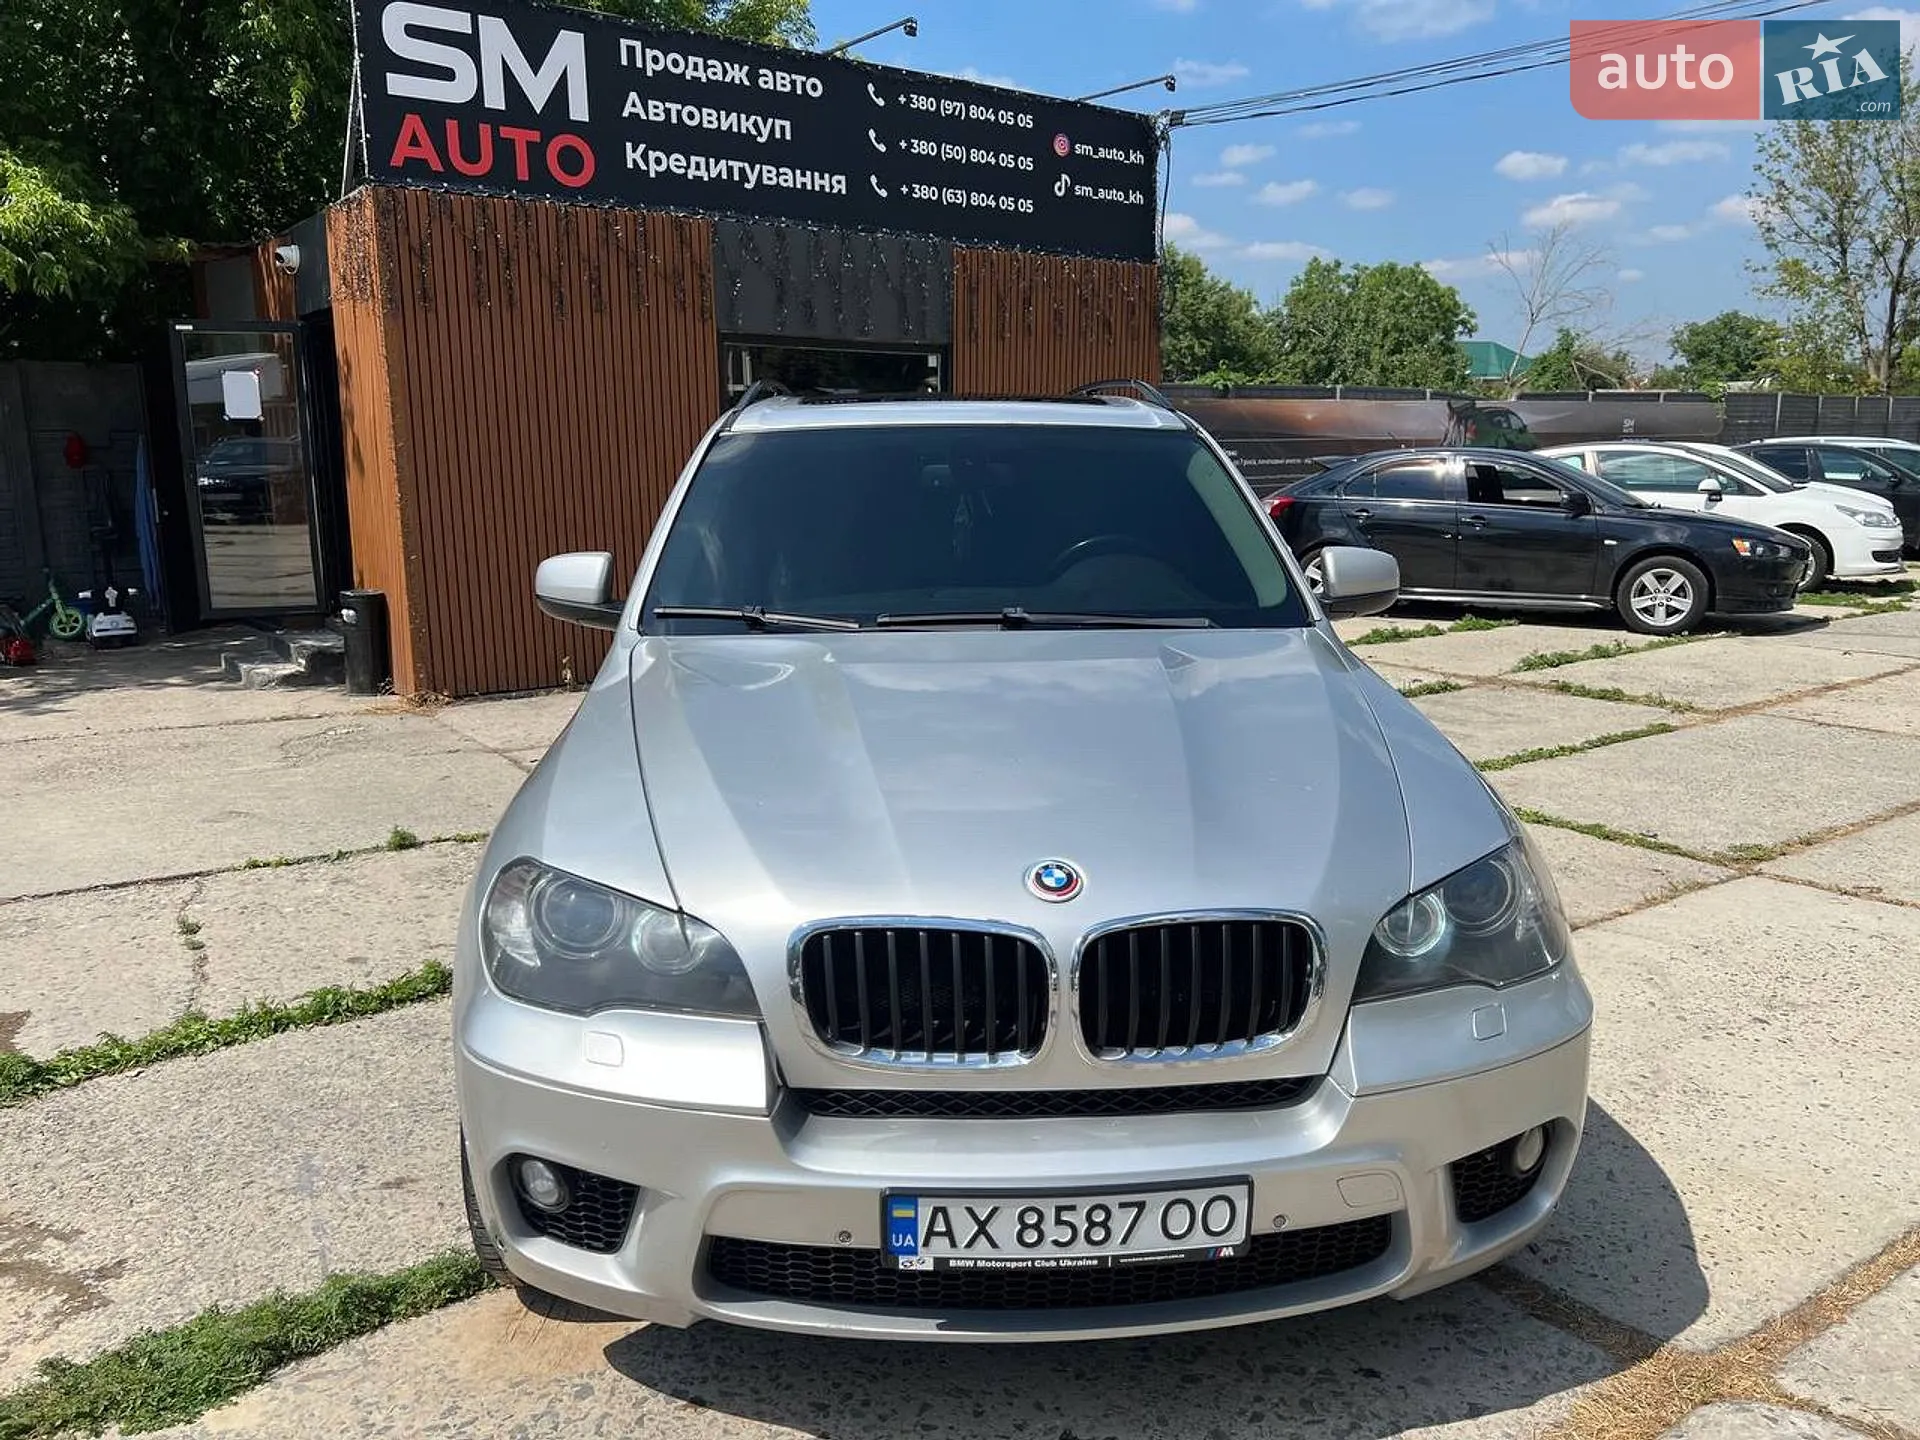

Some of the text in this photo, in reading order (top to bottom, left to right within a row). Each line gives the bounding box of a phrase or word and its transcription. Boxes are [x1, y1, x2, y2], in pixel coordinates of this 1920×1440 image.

[381, 1, 589, 122] SM
[619, 38, 824, 98] Продаж авто
[622, 91, 792, 143] Автовикуп
[898, 94, 1034, 129] + 380 (97) 804 05 05
[390, 113, 596, 188] AUTO
[899, 139, 1034, 171] + 380 (50) 804 05 05
[1074, 143, 1145, 165] sm_auto_kh
[625, 142, 848, 195] Кредитування
[900, 183, 1034, 213] + 380 (63) 804 05 05
[1074, 184, 1144, 205] sm_auto_kh
[892, 1232, 916, 1248] UA
[922, 1205, 1001, 1250] AX
[1014, 1199, 1149, 1250] 8587
[949, 1257, 1098, 1269] BMW Motorsport Club Ukraine
